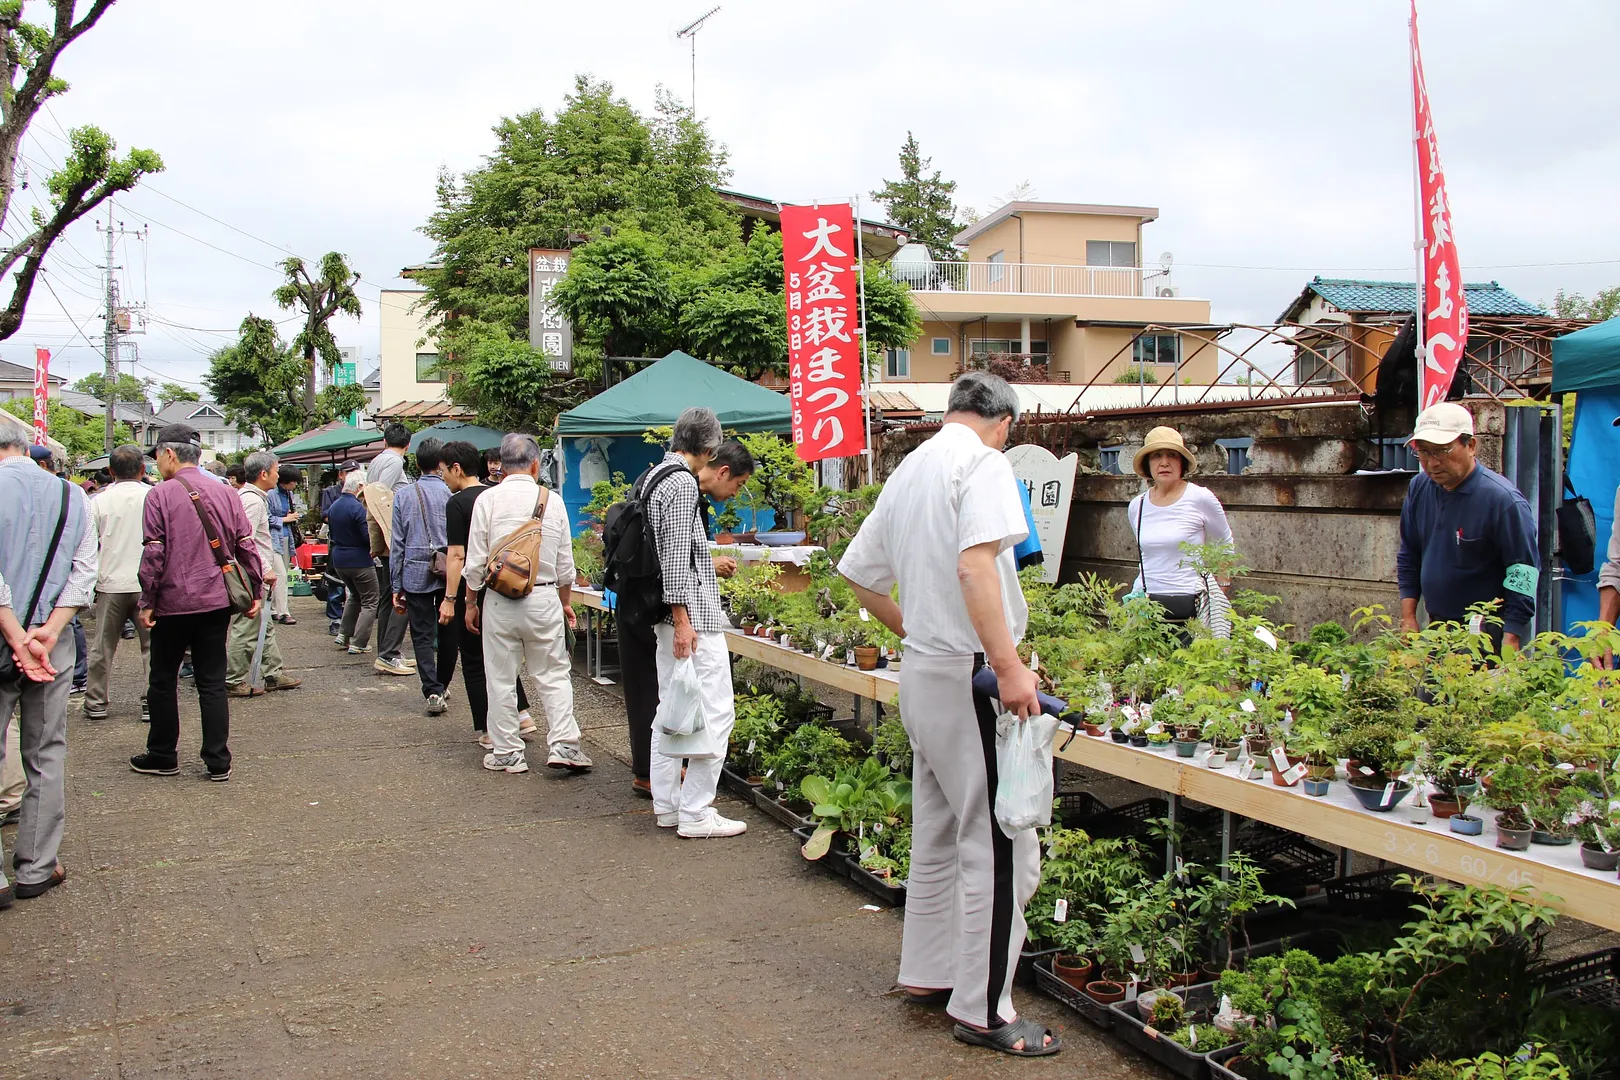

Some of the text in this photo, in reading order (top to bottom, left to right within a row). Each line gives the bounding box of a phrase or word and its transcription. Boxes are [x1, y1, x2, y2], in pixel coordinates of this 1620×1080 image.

[535, 255, 567, 273] 盆栽
[798, 217, 852, 453] 大盆栽まつり
